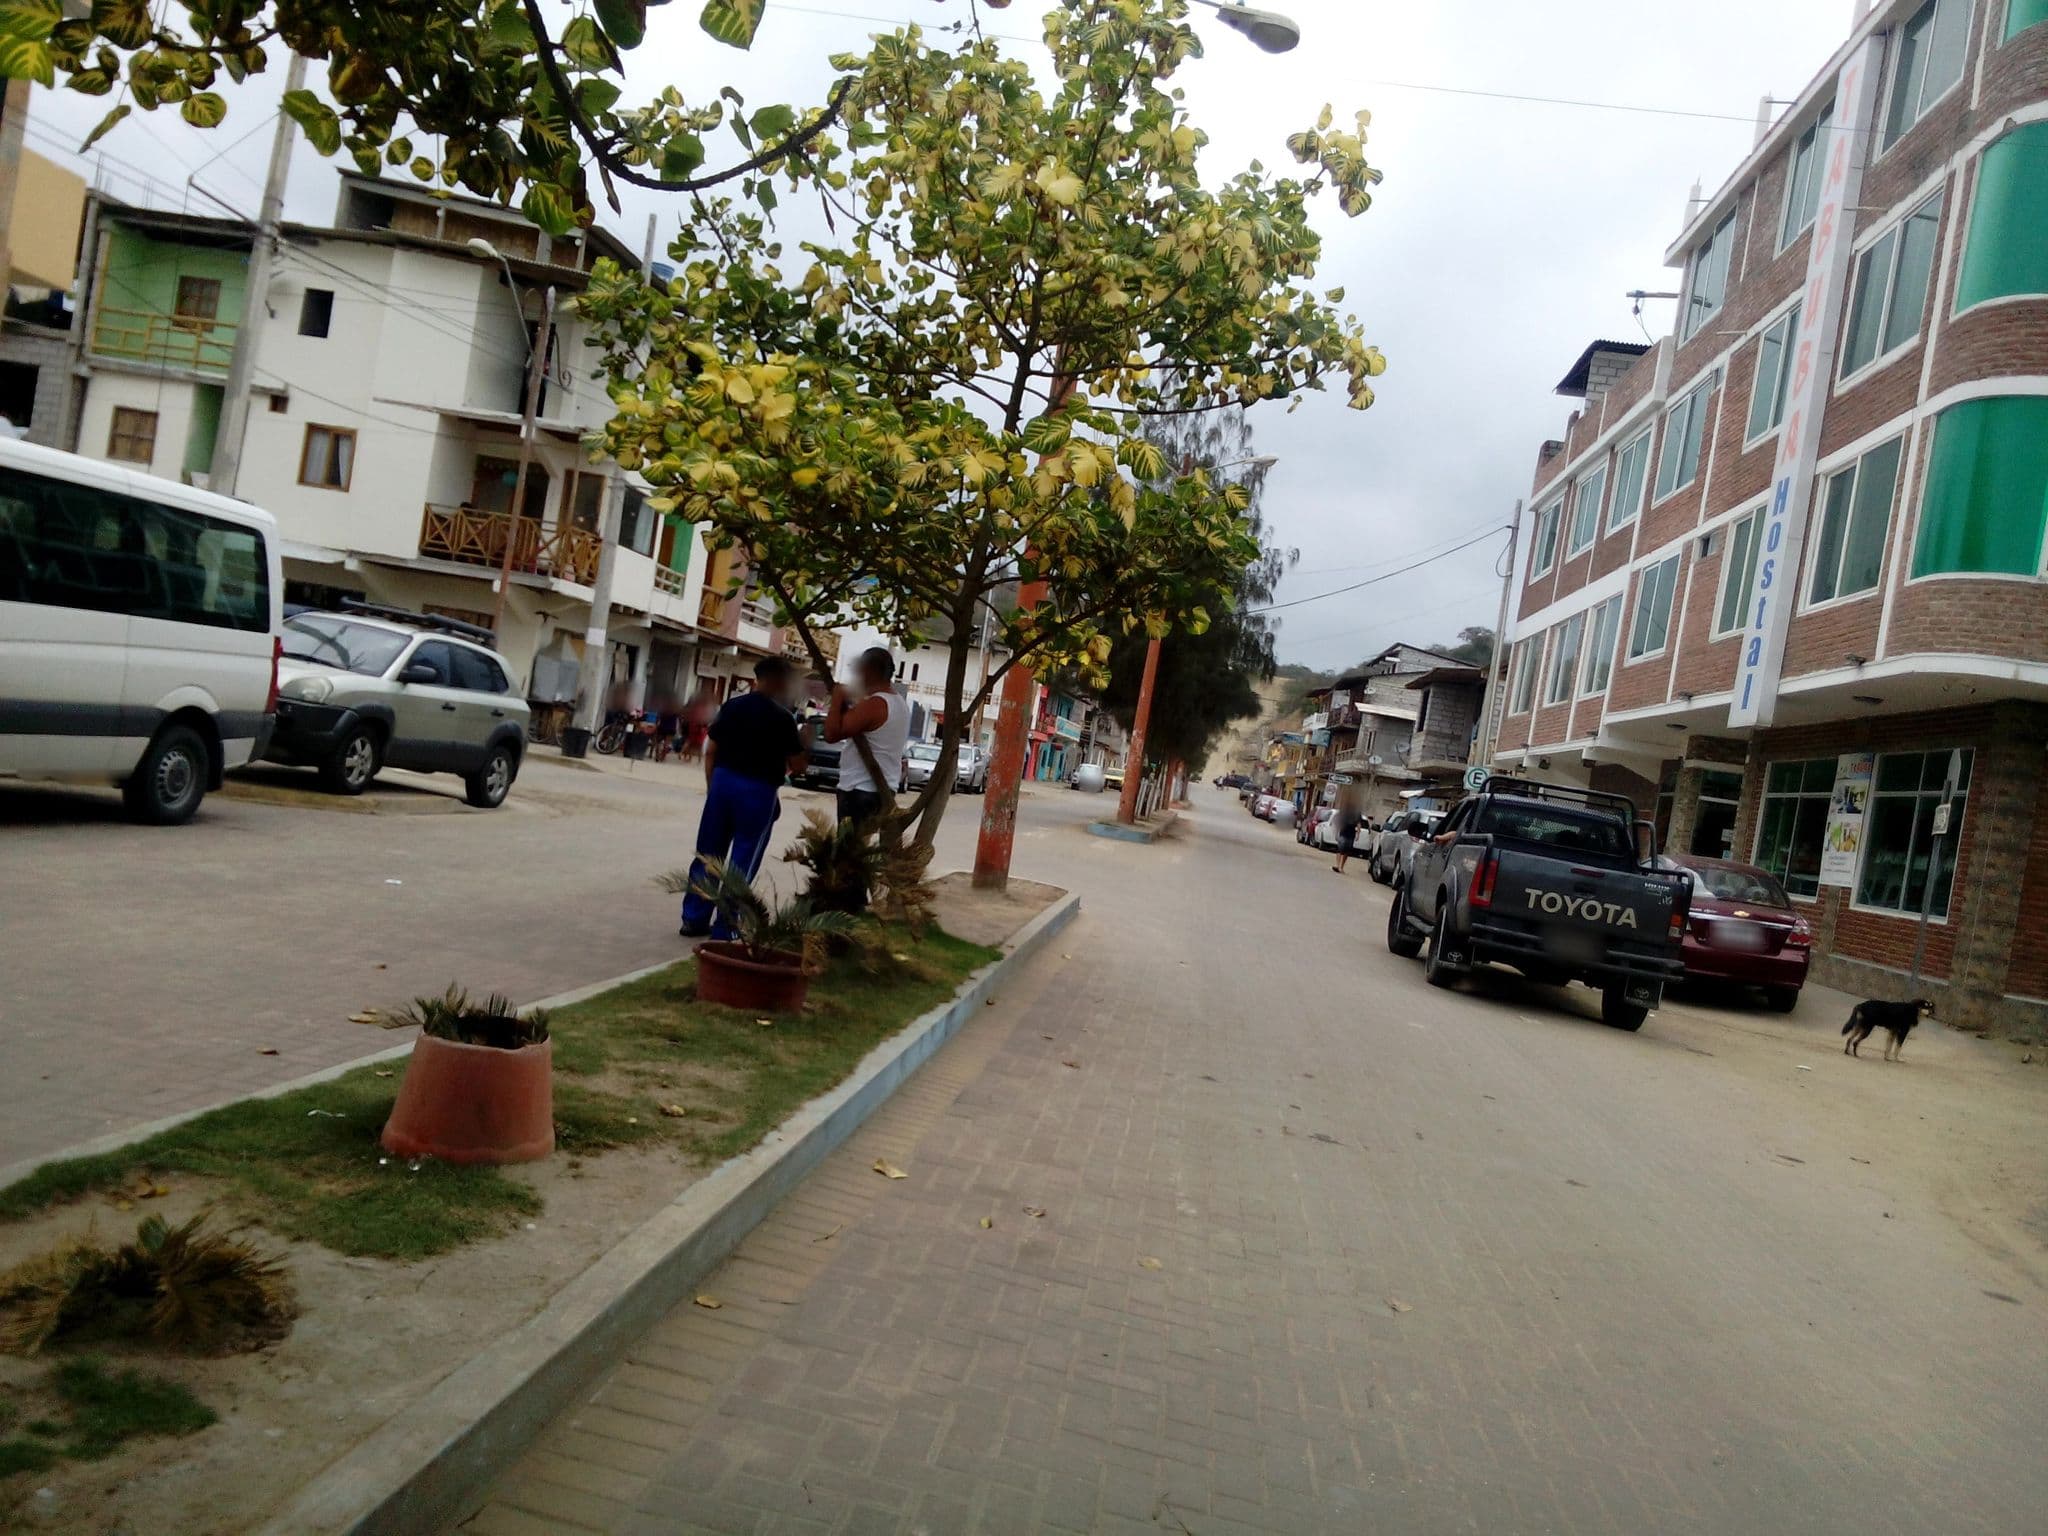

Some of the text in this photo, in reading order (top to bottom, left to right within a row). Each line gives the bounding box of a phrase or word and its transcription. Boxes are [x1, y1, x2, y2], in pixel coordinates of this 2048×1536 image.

[1741, 64, 1858, 710] TABUBA Hostal
[1473, 772, 1483, 785] E
[1525, 888, 1637, 929] TOYOTA
